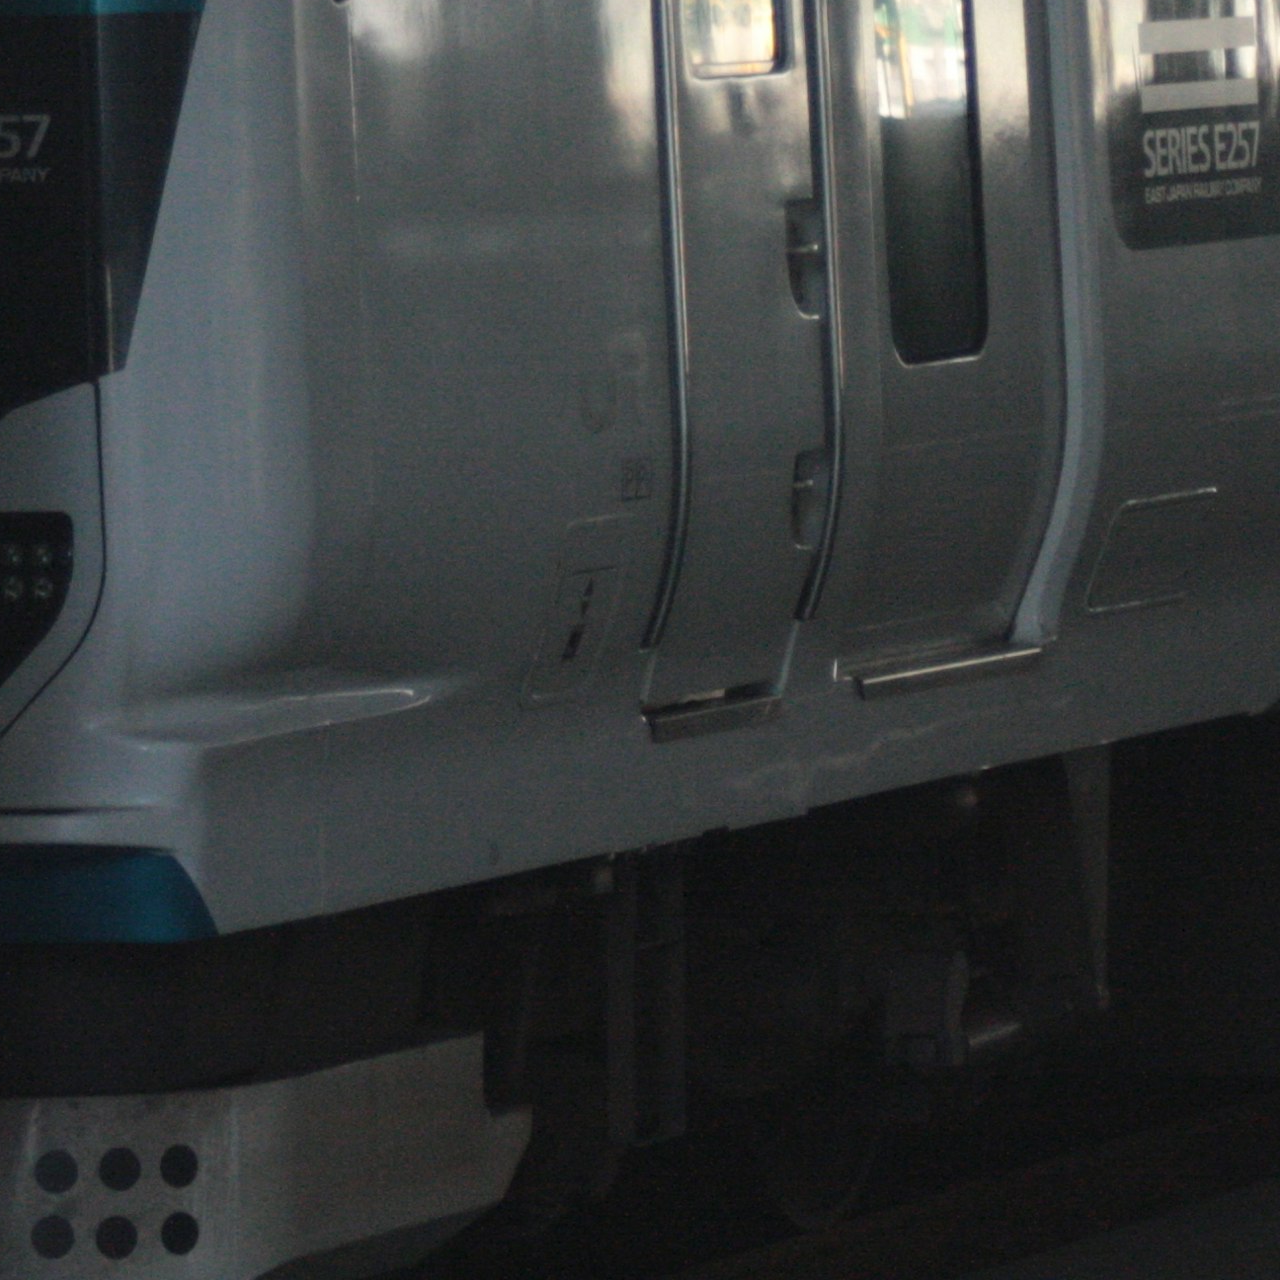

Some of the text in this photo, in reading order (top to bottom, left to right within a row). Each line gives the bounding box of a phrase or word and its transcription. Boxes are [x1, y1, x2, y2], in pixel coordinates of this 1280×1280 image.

[1142, 120, 1260, 178] SERIES E257
[1145, 185, 1166, 205] EAST
